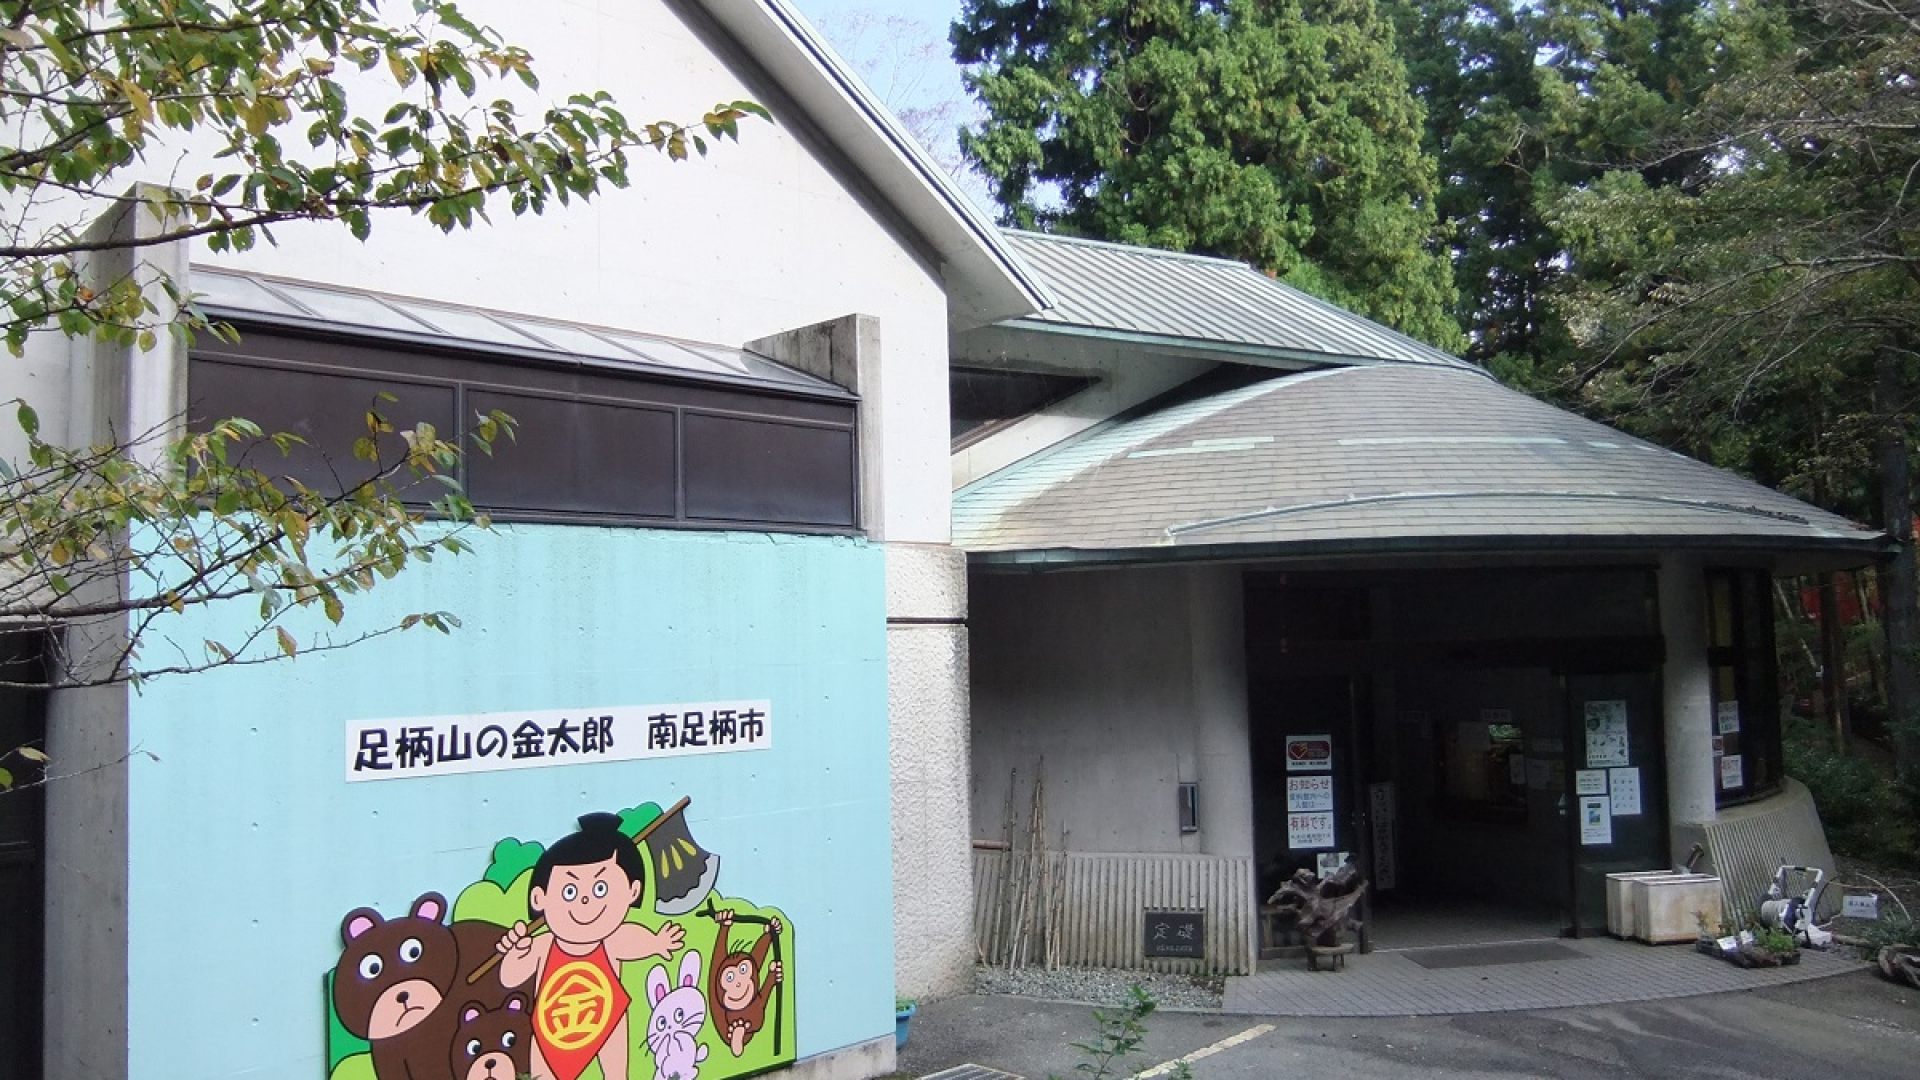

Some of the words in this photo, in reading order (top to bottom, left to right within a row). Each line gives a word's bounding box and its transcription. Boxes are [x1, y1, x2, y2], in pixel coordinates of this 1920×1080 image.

[353, 716, 614, 772] 足柄山の金太郎
[647, 708, 766, 750] 南足柄市
[1289, 779, 1330, 791] お知らせ
[1153, 922, 1195, 940] 定礎
[541, 971, 608, 1042] 金
